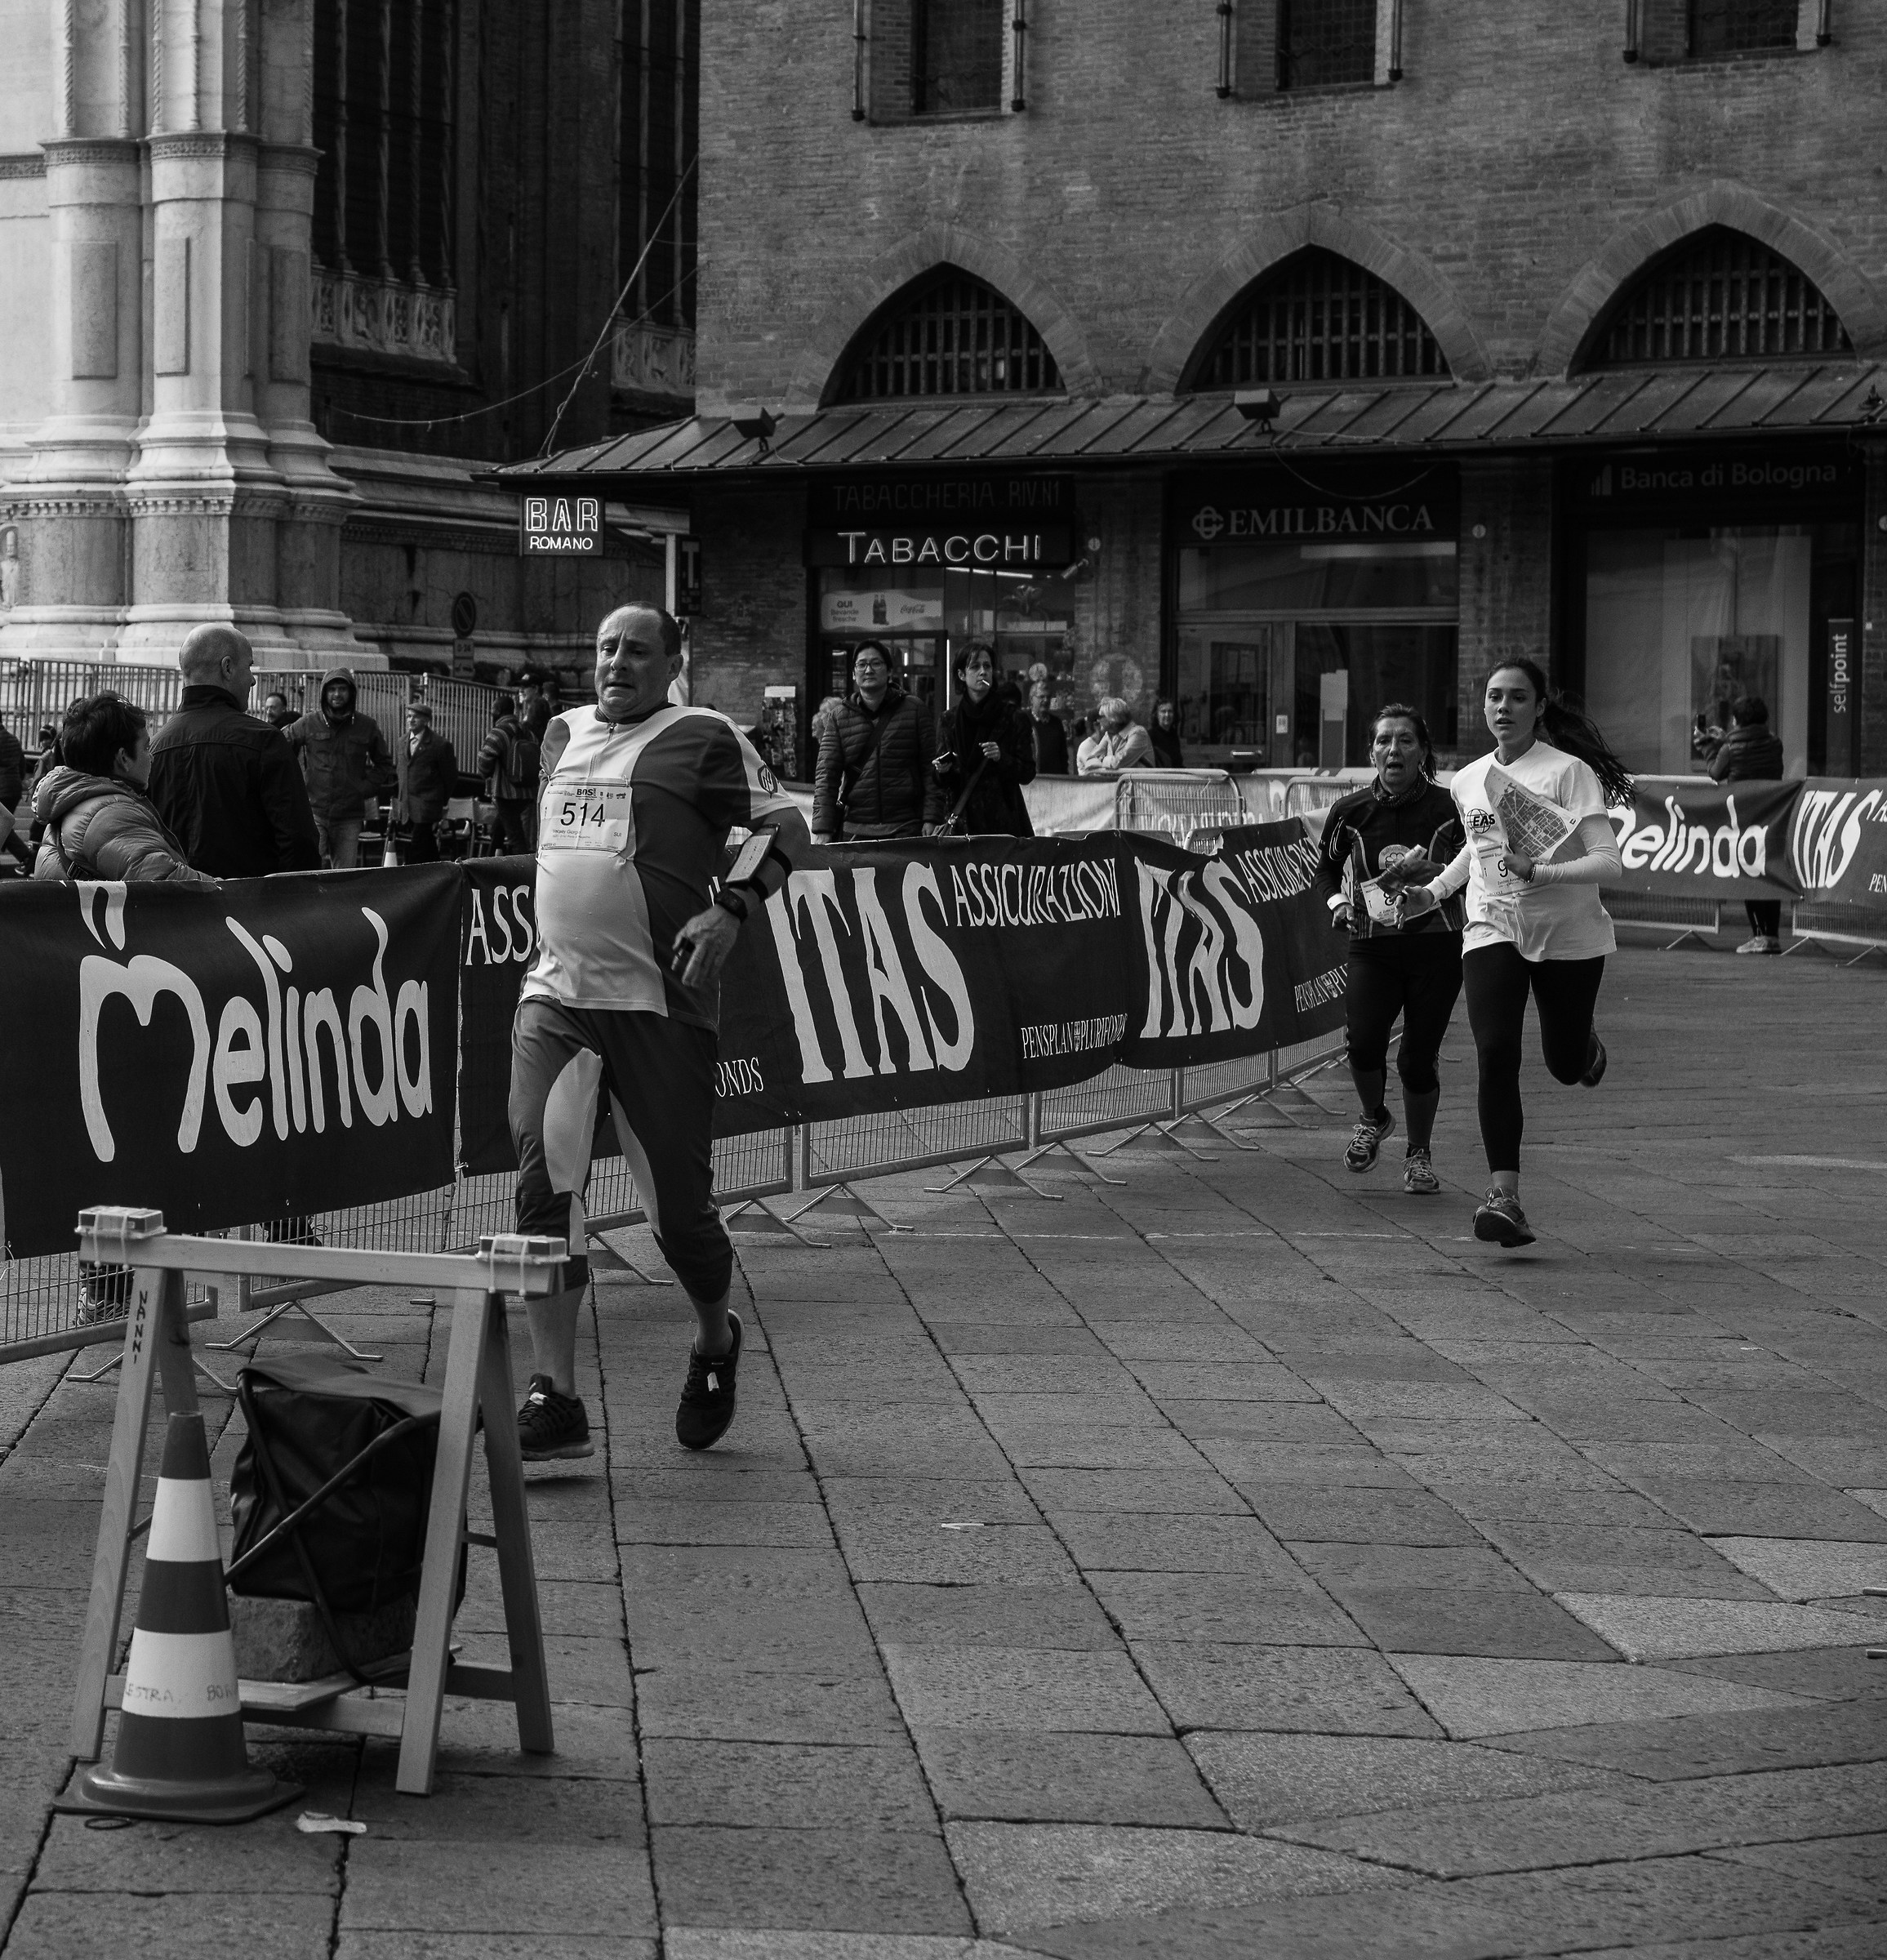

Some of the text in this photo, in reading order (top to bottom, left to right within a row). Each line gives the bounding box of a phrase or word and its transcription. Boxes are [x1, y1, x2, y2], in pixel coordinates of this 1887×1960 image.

[1621, 461, 1836, 490] Banca di Bologna
[526, 497, 599, 532] BAR
[1227, 503, 1435, 536] EMILBANCA
[529, 536, 594, 550] ROMANO
[837, 600, 852, 608] QUI
[1829, 633, 1850, 714] selfpoint
[560, 802, 605, 827] 514
[1473, 813, 1496, 826] EAS
[1792, 789, 1883, 889] ITAS
[950, 858, 1122, 927] ASSICURAZIONI
[1134, 856, 1265, 1039] ITAS
[764, 861, 975, 1085] ITAS
[1021, 1022, 1074, 1059] PENSPLAN
